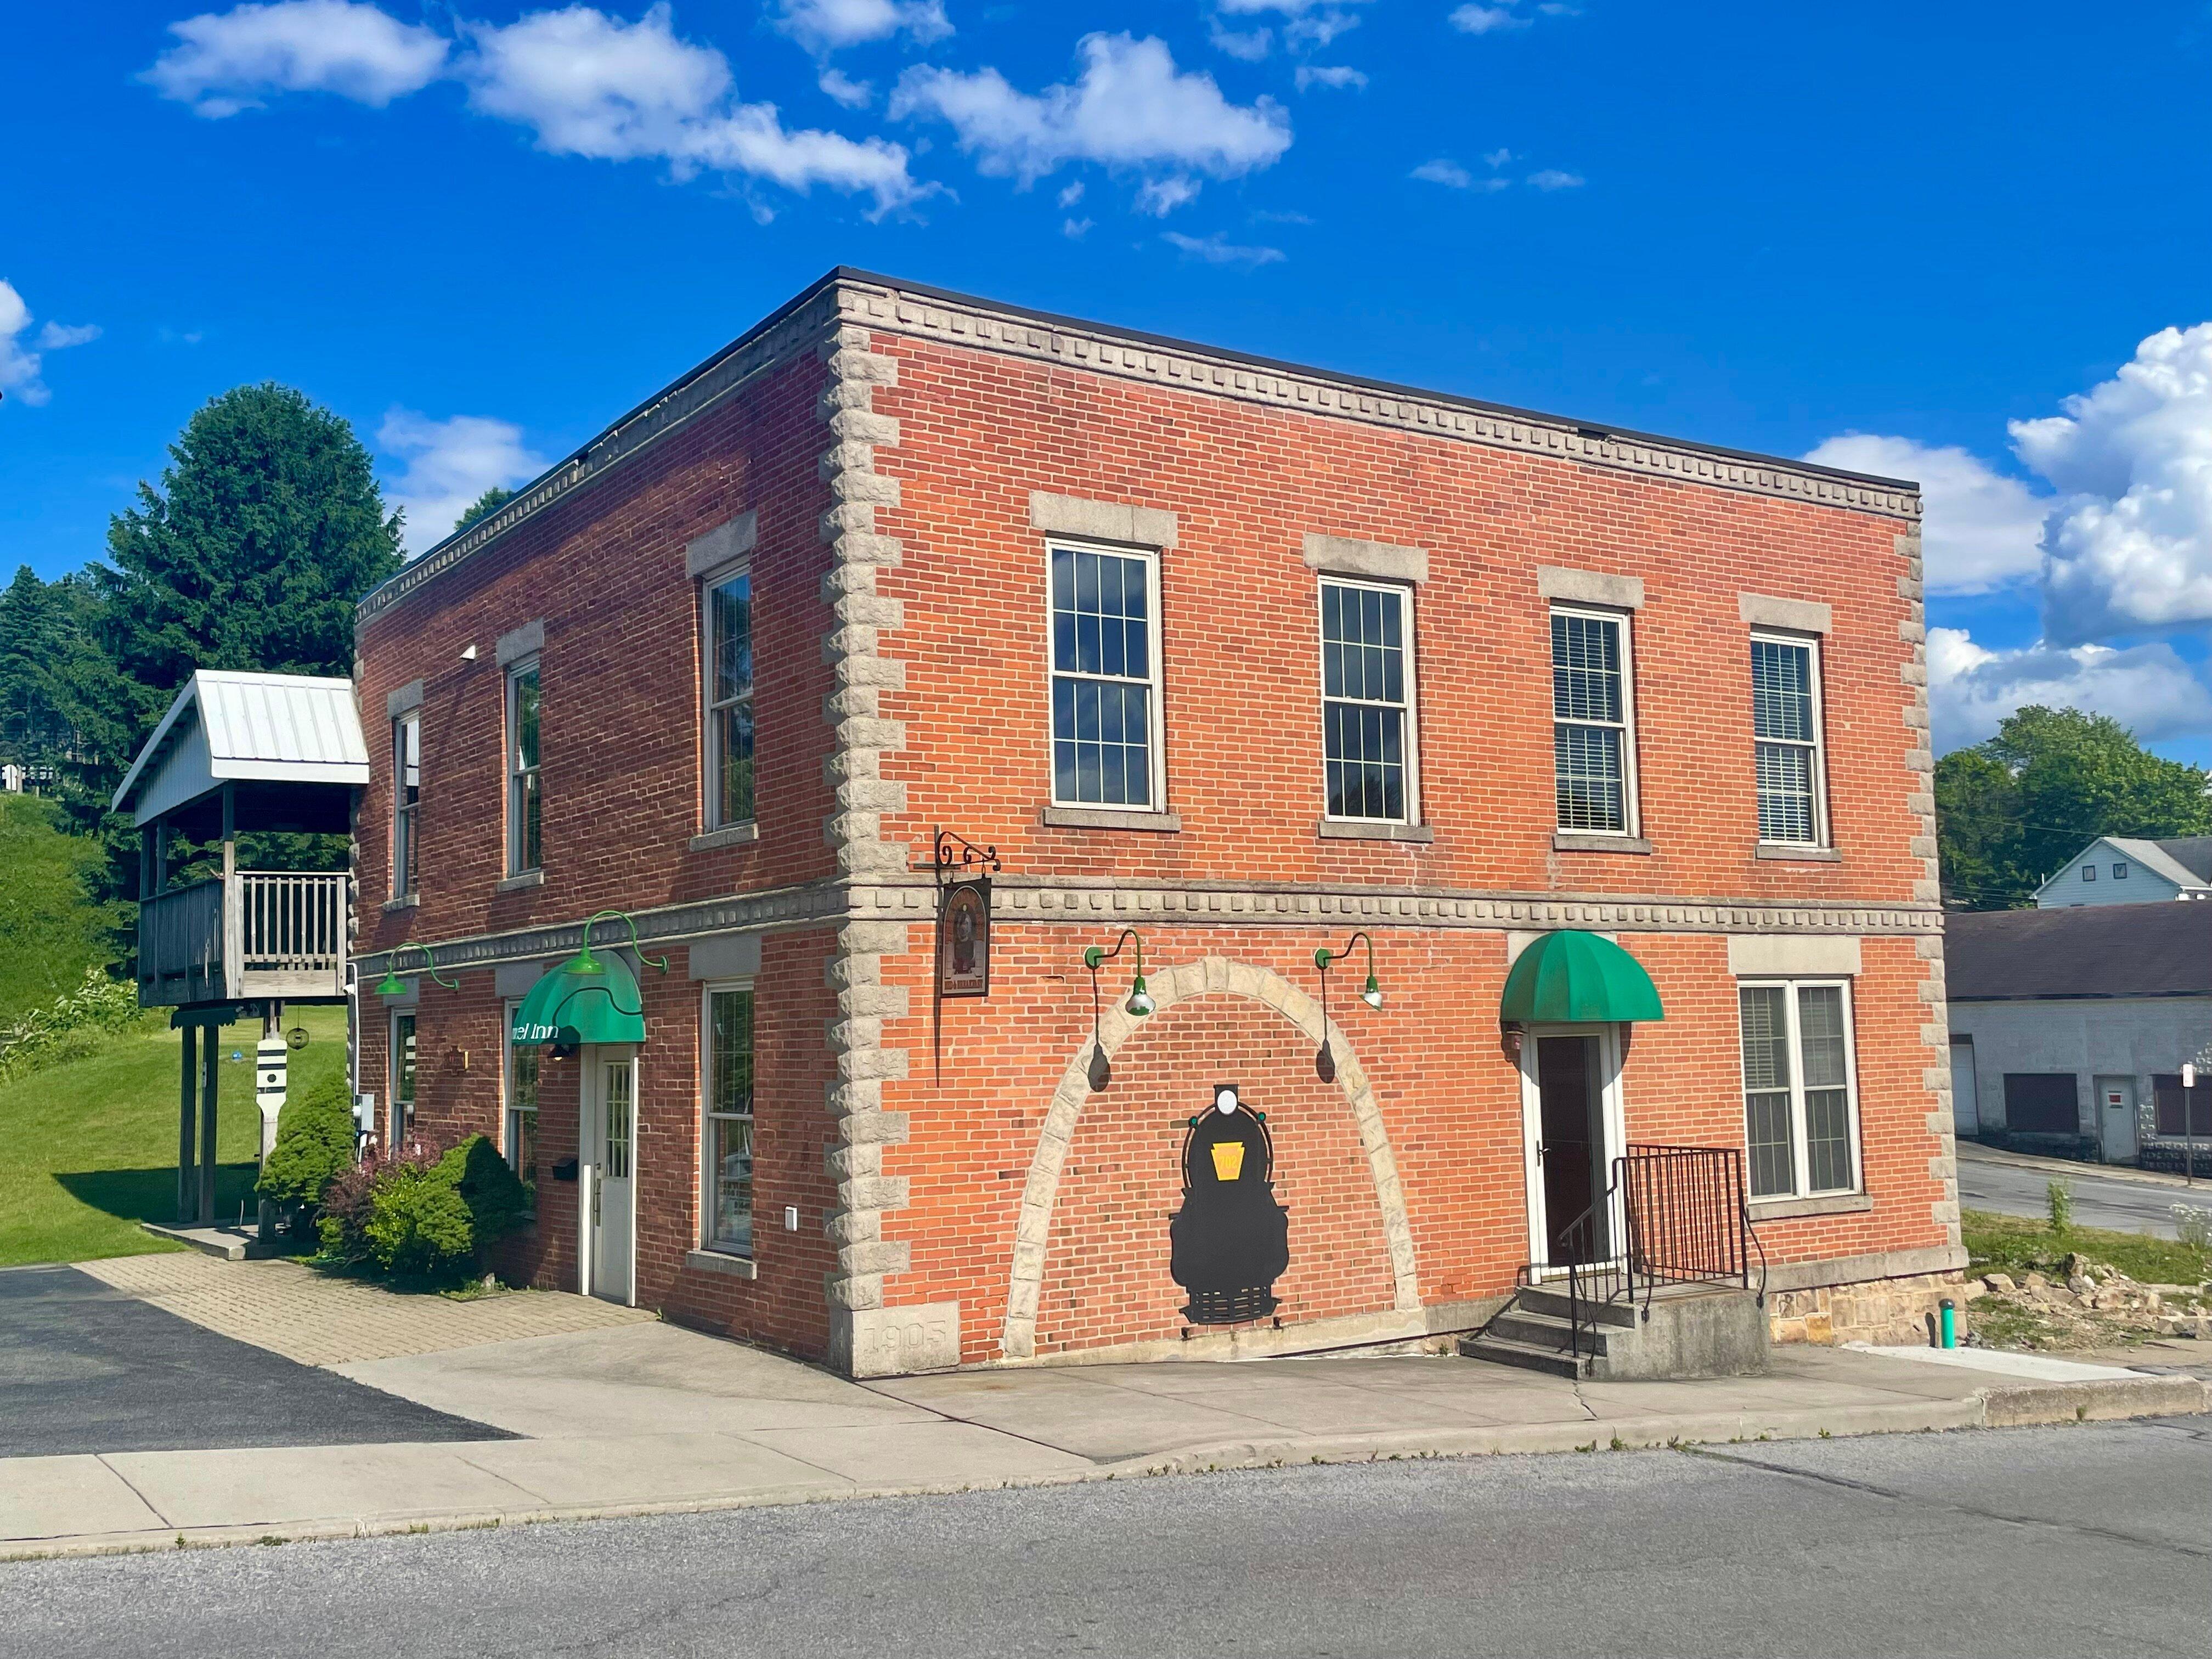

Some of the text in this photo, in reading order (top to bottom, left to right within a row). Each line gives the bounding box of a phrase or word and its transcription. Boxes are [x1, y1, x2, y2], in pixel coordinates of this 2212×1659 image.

[531, 1023, 559, 1039] Inn
[1220, 1155, 1238, 1170] 702
[864, 1320, 946, 1352] 1905
